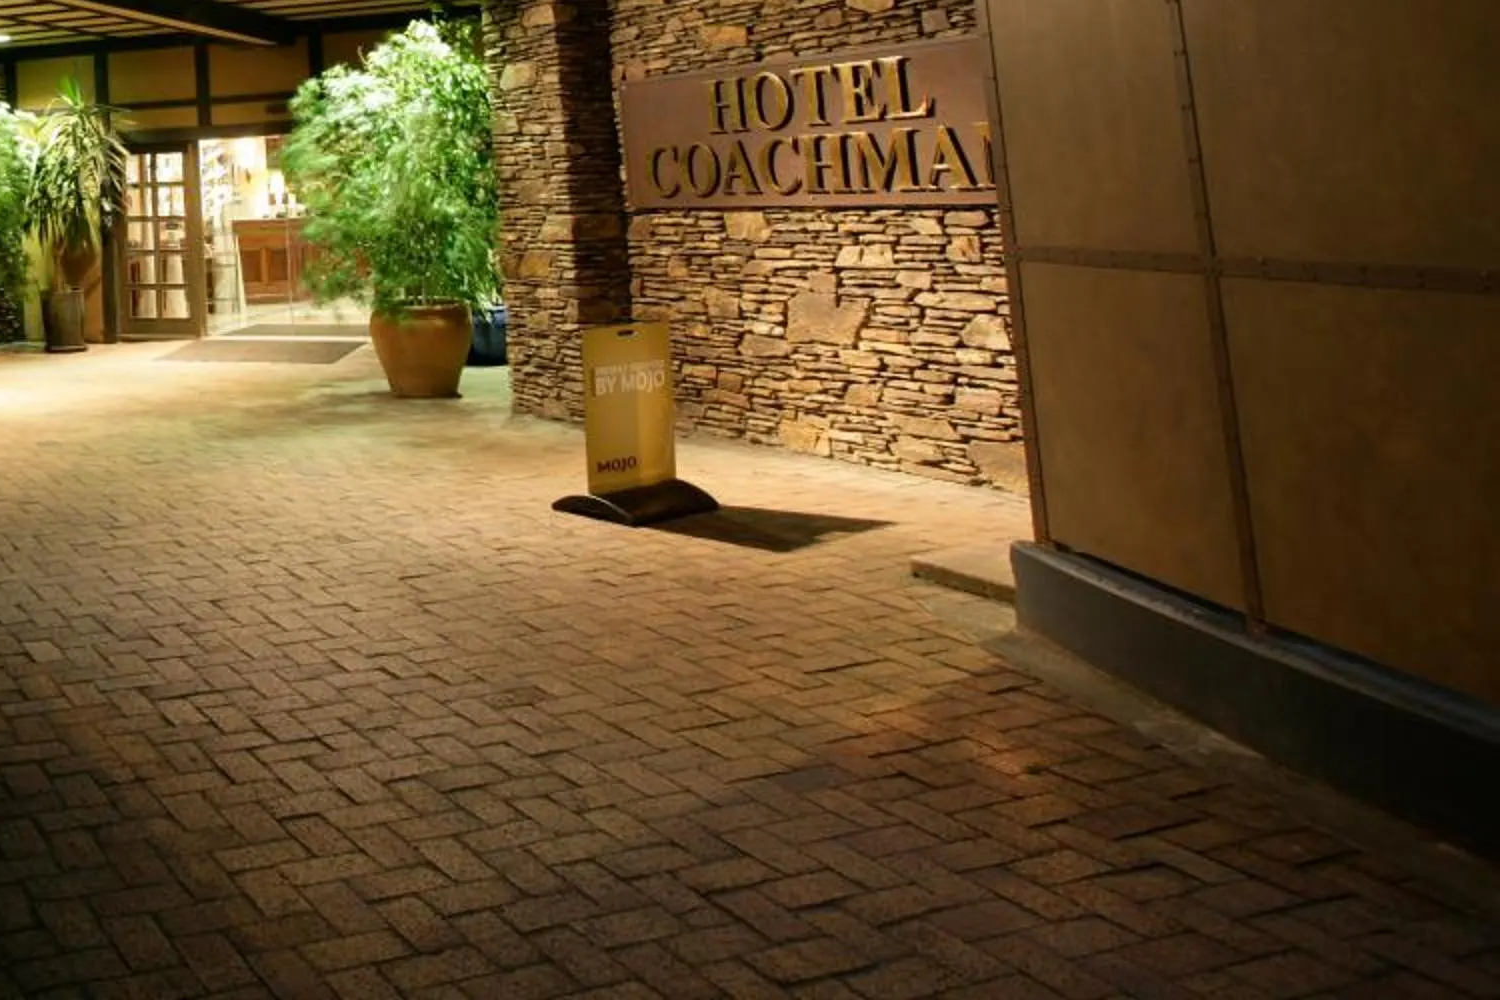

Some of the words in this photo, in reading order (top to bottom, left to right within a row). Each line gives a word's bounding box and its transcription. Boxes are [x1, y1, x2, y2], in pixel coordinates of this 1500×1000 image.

[708, 56, 936, 135] HOTEL
[621, 370, 665, 393] MOJO
[596, 456, 637, 473] MOJO
